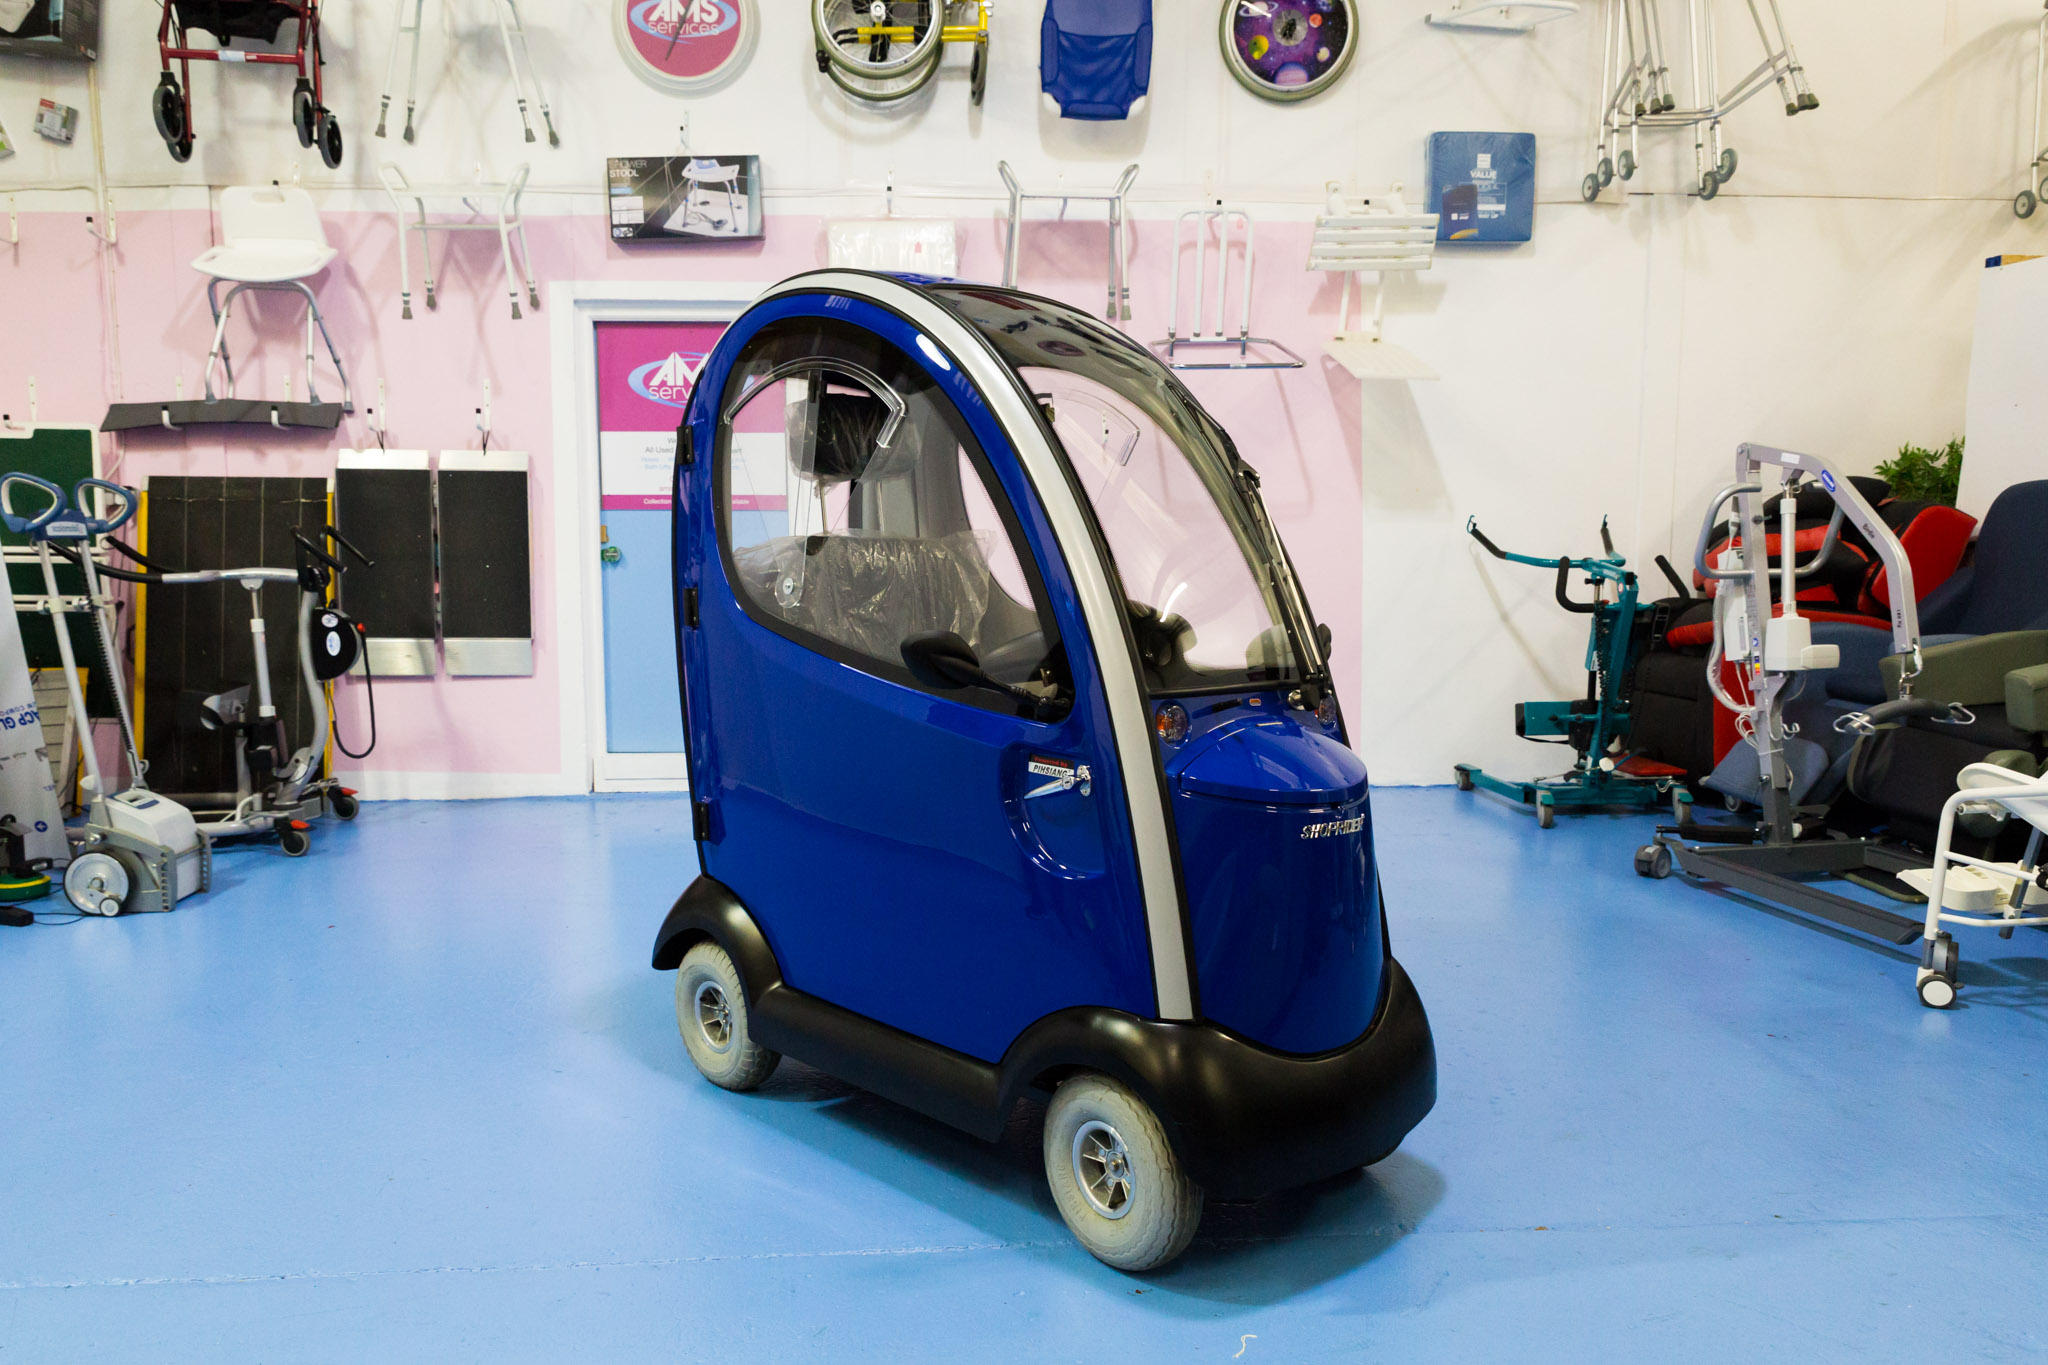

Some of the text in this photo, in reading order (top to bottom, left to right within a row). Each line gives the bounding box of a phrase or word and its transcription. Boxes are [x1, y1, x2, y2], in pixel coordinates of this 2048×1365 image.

[647, 0, 720, 23] AMS
[647, 20, 721, 36] services
[609, 159, 648, 169] SHOWER
[609, 168, 640, 178] STOOL
[1469, 170, 1497, 179] VALUE
[648, 351, 711, 387] AM
[648, 385, 695, 400] serv
[1032, 764, 1068, 778] PIHSIANG
[1300, 817, 1363, 839] SHOPRIDER
